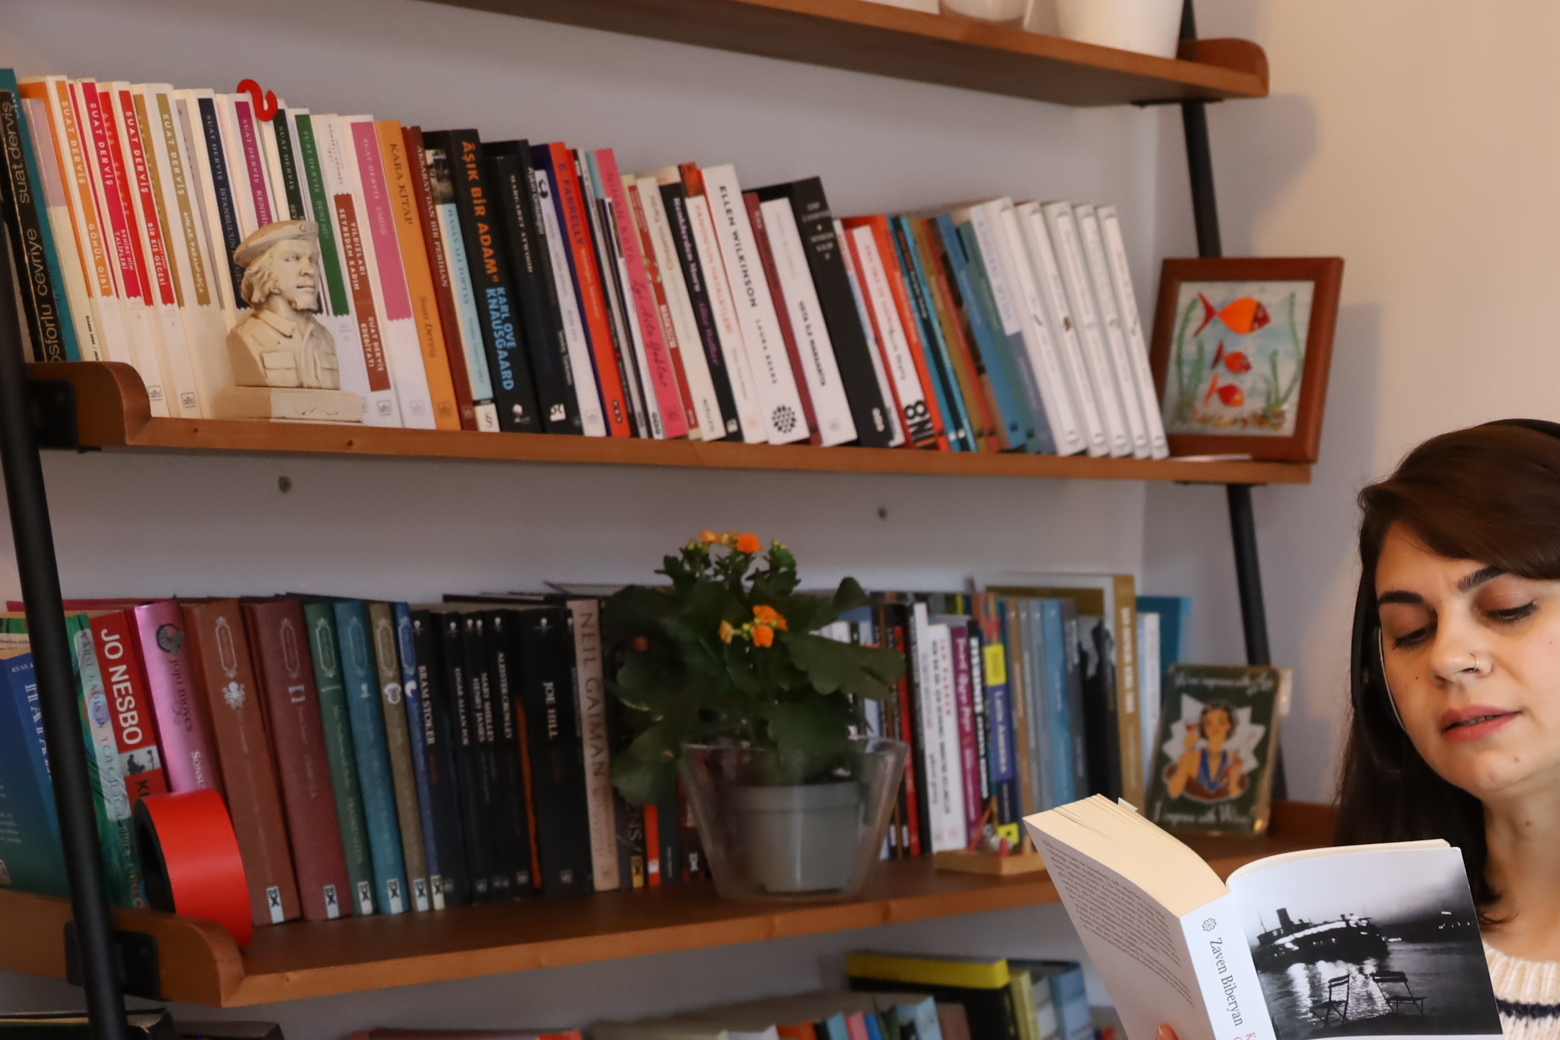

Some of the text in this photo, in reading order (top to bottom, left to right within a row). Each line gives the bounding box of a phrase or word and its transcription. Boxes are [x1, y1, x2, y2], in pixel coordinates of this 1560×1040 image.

[2, 100, 23, 160] derviş
[90, 103, 114, 186] SUAT DERVİŞ
[125, 111, 149, 193] SUAT DERVİŞ
[162, 113, 175, 146] SUAT
[170, 151, 186, 195] DERVİŞ
[206, 115, 216, 140] SUAT
[211, 143, 224, 181] DERVİŞ
[243, 118, 260, 184] SUAT DERVİŞ
[279, 126, 295, 190] SUAT DERVİŞ
[303, 130, 312, 154] SUAT
[461, 141, 480, 181] ÂŞIK
[12, 163, 30, 204] suat
[62, 101, 110, 290] SUAT DERVİŞ GÖNÜL GİBİ
[363, 138, 373, 161] SUAT
[368, 163, 379, 200] DERVİŞ
[390, 143, 414, 226] KARA KİTAP
[470, 186, 488, 217] BİR
[416, 144, 449, 288] AKSARAY'DAN BİR PERİHAN
[509, 174, 534, 274] MARGARET ATWOOD
[562, 179, 586, 246] FARRELLY
[673, 197, 693, 261] Renklerden
[688, 262, 701, 293] Moru
[26, 228, 48, 296] cevriye
[114, 231, 128, 270] TALİPLERİ
[147, 222, 168, 287] BİR KIŞ GECESİ
[339, 208, 361, 291] SEYREDEN KADIN
[351, 222, 366, 276] YILDIZLARI
[718, 185, 735, 226] ELLEN
[731, 231, 759, 307] WILKINSON
[755, 319, 768, 352] LAURA
[419, 295, 430, 320] Suat
[485, 287, 515, 391] KNAUSGAARD
[495, 286, 518, 349] KARL OVE
[360, 322, 375, 369] EDEBİYATI
[368, 316, 384, 372] SUAT DERVİŞ
[101, 628, 124, 660] JO
[109, 664, 144, 746] NESBO
[169, 659, 194, 733] jojo moyes
[418, 665, 436, 746] BRAM STOKER
[454, 667, 464, 695] EDGAR
[458, 695, 468, 728] ALLAN
[480, 672, 490, 697] MARY
[543, 681, 559, 738] JOE HILL
[579, 611, 607, 778] NEIL GAIMAN
[1209, 937, 1244, 1027] Zaven Biberyan
